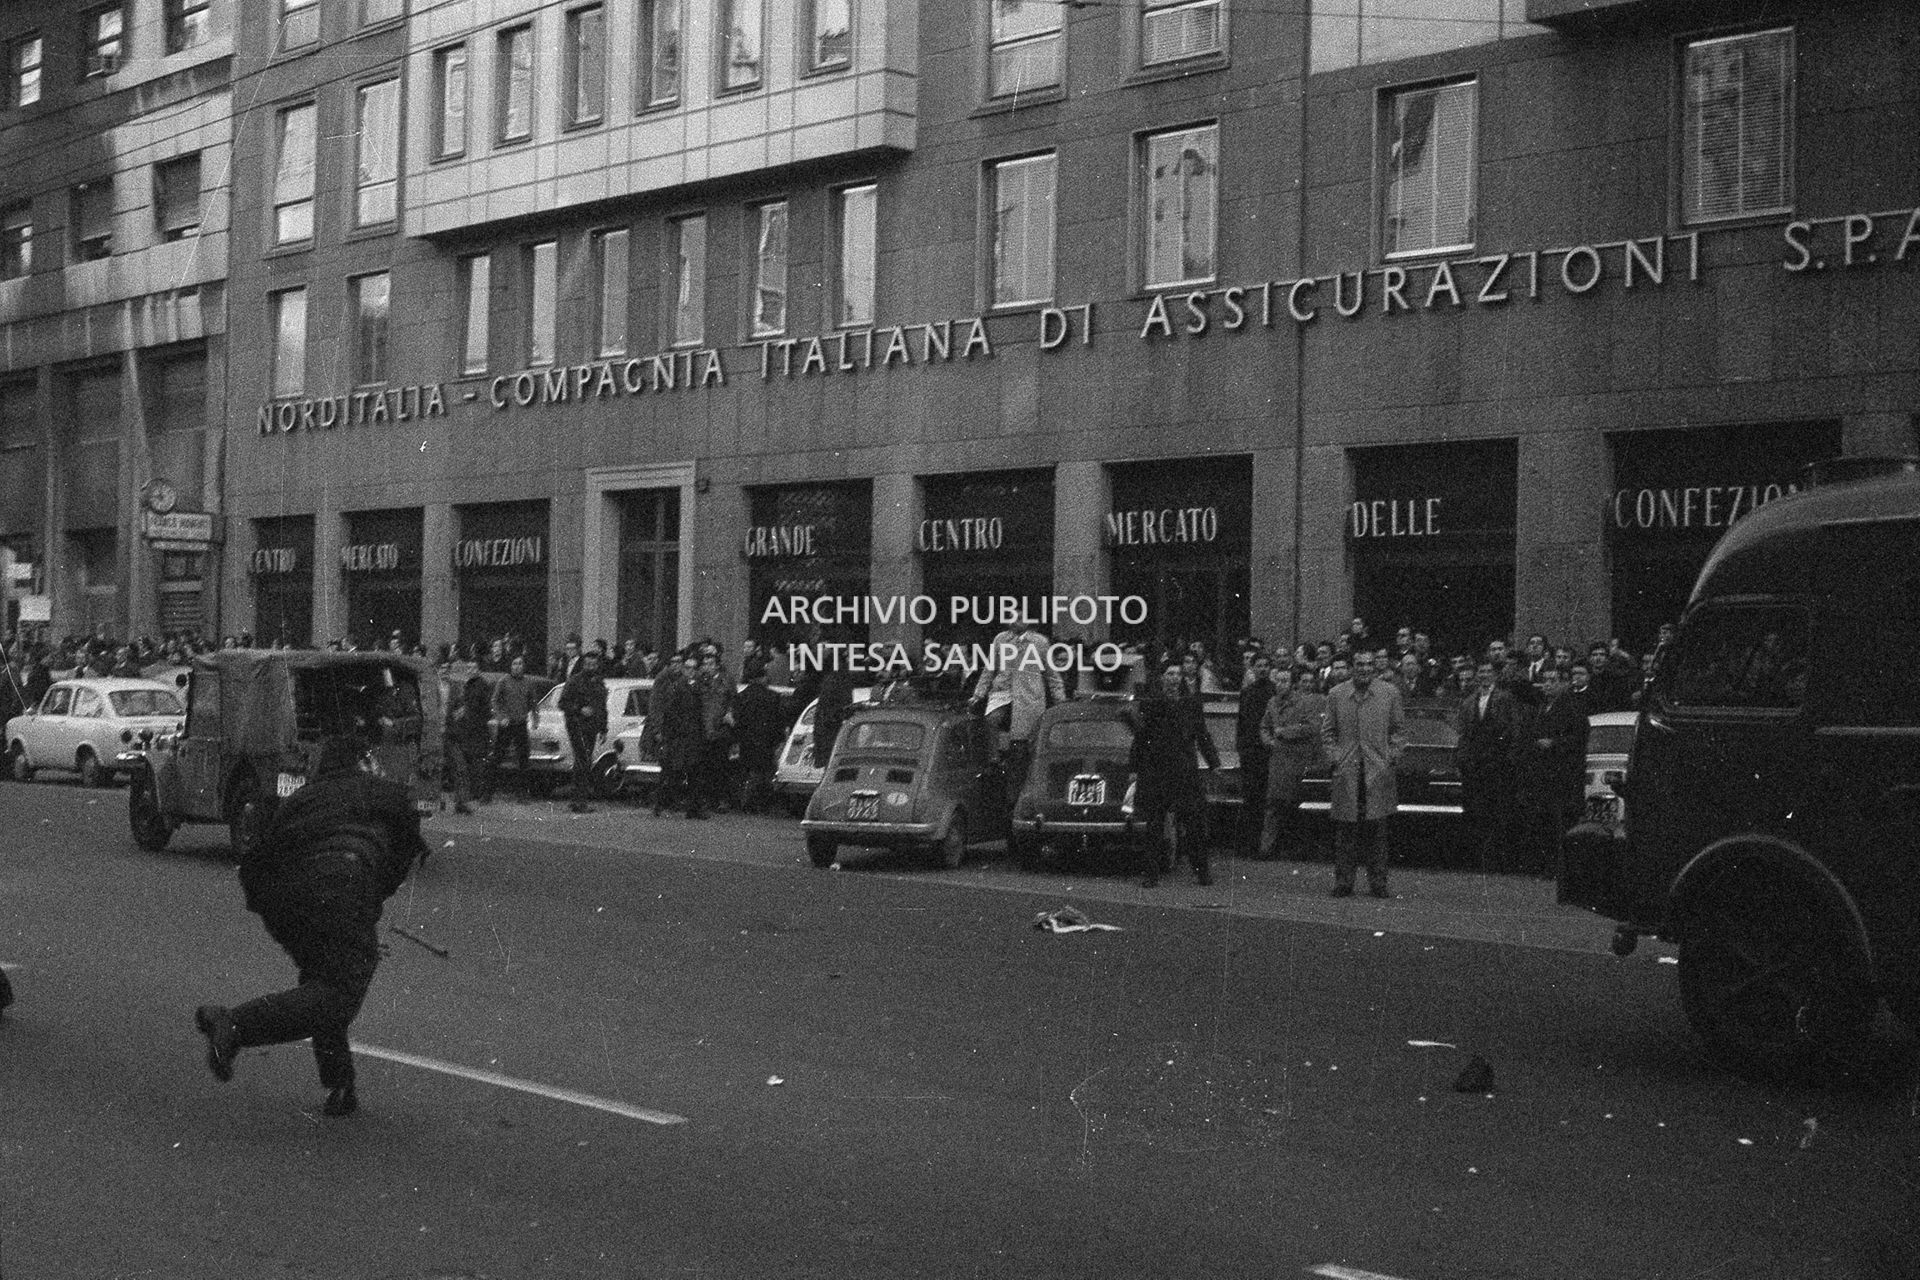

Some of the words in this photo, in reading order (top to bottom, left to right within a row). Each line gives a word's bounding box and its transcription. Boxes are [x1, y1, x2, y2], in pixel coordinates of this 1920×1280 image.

[257, 382, 446, 436] NORDITALIA
[490, 347, 726, 409] COMPAGNIA
[760, 315, 991, 379] ITALIANA
[1039, 301, 1091, 349] DI
[1140, 230, 1699, 340] ASSICURAZIONI
[454, 535, 542, 569] CONFEZIONI
[744, 524, 817, 557] GRANDE
[918, 515, 1003, 552] CENTRO
[1106, 506, 1218, 546] MERCATO
[1352, 498, 1441, 539] DELLE
